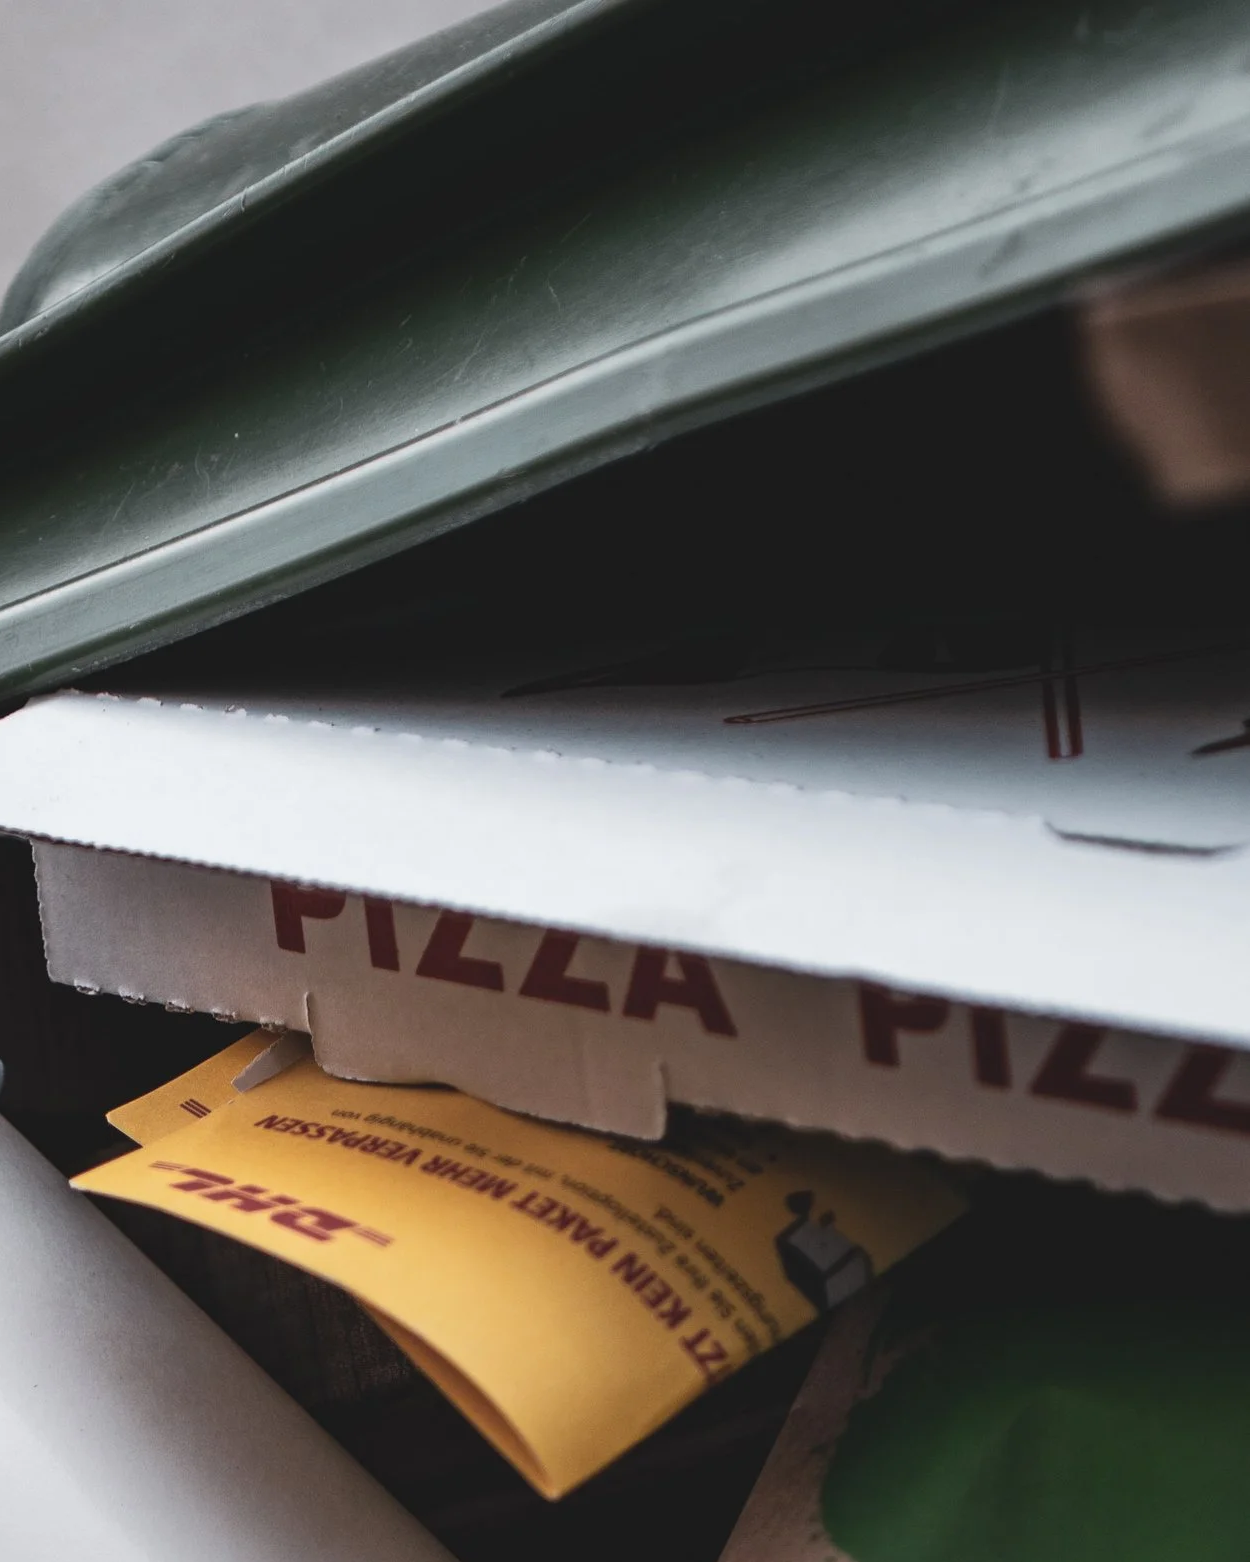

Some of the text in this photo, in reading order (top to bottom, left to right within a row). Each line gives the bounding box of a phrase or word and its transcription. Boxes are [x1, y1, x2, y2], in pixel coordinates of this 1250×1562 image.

[271, 878, 738, 1039] PIZZA
[253, 1112, 421, 1168] VERPASSEN
[330, 1108, 362, 1119] von
[364, 1114, 461, 1146] unabhängig
[418, 1154, 517, 1202] MEHR
[462, 1142, 488, 1158] Sie
[170, 1167, 355, 1244] DHL
[508, 1188, 619, 1259] PAKET
[609, 1249, 692, 1331] KEIN
